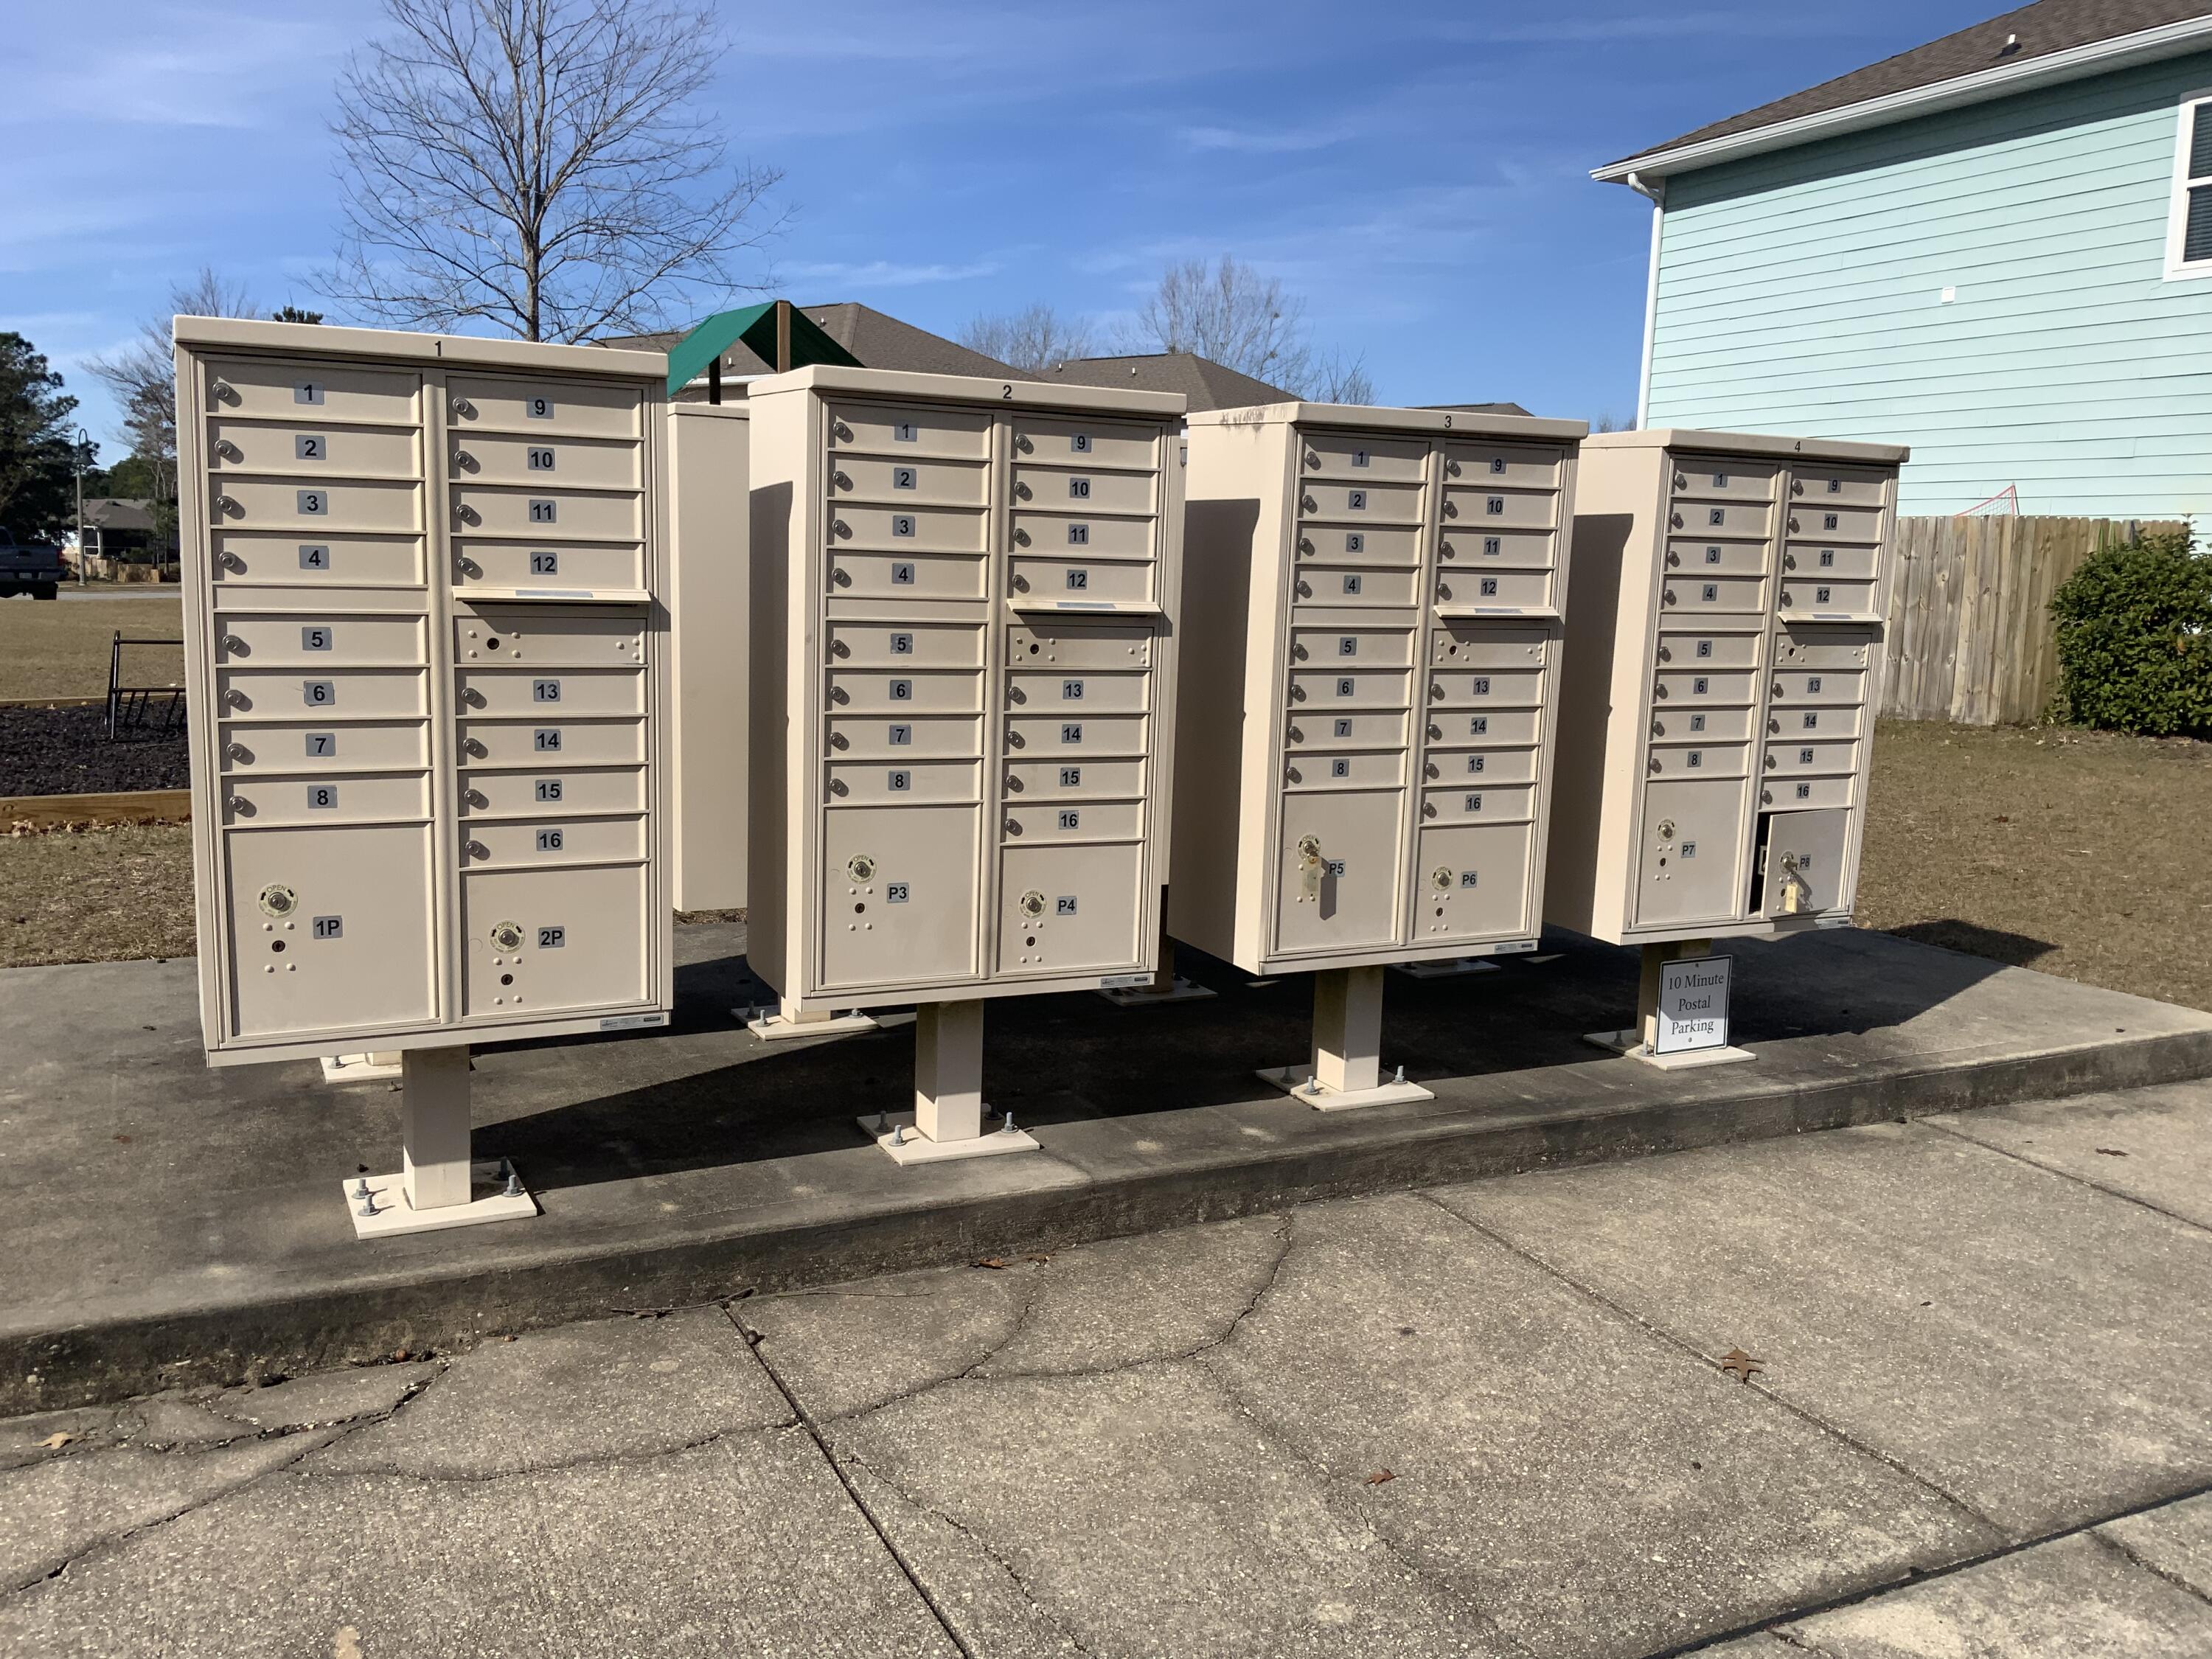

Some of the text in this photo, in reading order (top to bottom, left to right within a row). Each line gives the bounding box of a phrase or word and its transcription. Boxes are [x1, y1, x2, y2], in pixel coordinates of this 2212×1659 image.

[1003, 384, 1012, 400] 2
[535, 399, 546, 415] 9
[1444, 415, 1452, 429] 3
[305, 439, 317, 456] 2
[1077, 435, 1086, 450] 9
[1794, 441, 1801, 453] 4
[531, 451, 553, 468] 10
[1495, 458, 1502, 472] 9
[900, 471, 910, 487] 2
[1832, 479, 1838, 491] 9
[1071, 481, 1089, 496] 10
[307, 495, 319, 512] 3
[1353, 494, 1362, 507] 2
[1489, 499, 1503, 513] 10
[532, 504, 552, 520] 11
[1713, 512, 1720, 524] 2
[900, 519, 909, 535] 3
[1825, 516, 1837, 529] 10
[1071, 527, 1085, 542] 11
[1351, 537, 1359, 550] 3
[1486, 540, 1498, 553] 11
[308, 549, 321, 566] 4
[1710, 549, 1717, 562] 3
[1821, 553, 1832, 565] 11
[533, 556, 556, 572] 12
[898, 567, 908, 582] 4
[1069, 573, 1086, 588] 12
[1348, 578, 1356, 592] 4
[1482, 581, 1496, 594] 12
[1706, 587, 1714, 599] 4
[1818, 589, 1829, 602] 12
[311, 631, 324, 647] 5
[897, 637, 906, 651] 5
[1344, 640, 1352, 653] 5
[1701, 644, 1708, 655] 5
[313, 685, 325, 701] 6
[537, 684, 558, 699] 13
[896, 684, 905, 698] 6
[1065, 684, 1082, 698] 13
[1342, 681, 1349, 695] 6
[1475, 681, 1488, 693] 13
[1697, 681, 1705, 692] 6
[1809, 680, 1820, 692] 13
[1340, 722, 1348, 734] 7
[1472, 720, 1486, 733] 14
[1695, 717, 1702, 729] 7
[1805, 715, 1817, 727] 14
[537, 733, 560, 748] 14
[896, 728, 905, 742] 7
[1063, 727, 1081, 741] 14
[315, 737, 327, 754] 7
[1691, 754, 1698, 765] 8
[1801, 751, 1813, 762] 15
[1337, 762, 1344, 775] 8
[1469, 758, 1484, 771] 15
[895, 773, 904, 788] 8
[1062, 771, 1079, 785] 15
[317, 790, 329, 806] 8
[538, 783, 560, 799] 15
[1798, 785, 1809, 797] 16
[1467, 797, 1481, 810] 16
[1060, 813, 1078, 827] 16
[539, 832, 561, 849] 16
[1682, 844, 1695, 856] P7
[1329, 863, 1343, 874] P5
[1799, 857, 1810, 868] P8
[1462, 874, 1476, 886] P6
[267, 884, 286, 893] OPEN
[888, 886, 907, 900] P3
[1058, 899, 1076, 912] P4
[316, 919, 340, 936] 1P
[497, 922, 515, 931] OPEN
[540, 930, 563, 946] 2P
[1669, 974, 1724, 990] 10 Minute
[1677, 995, 1711, 1012] Postal
[1671, 1019, 1714, 1035] Parking
